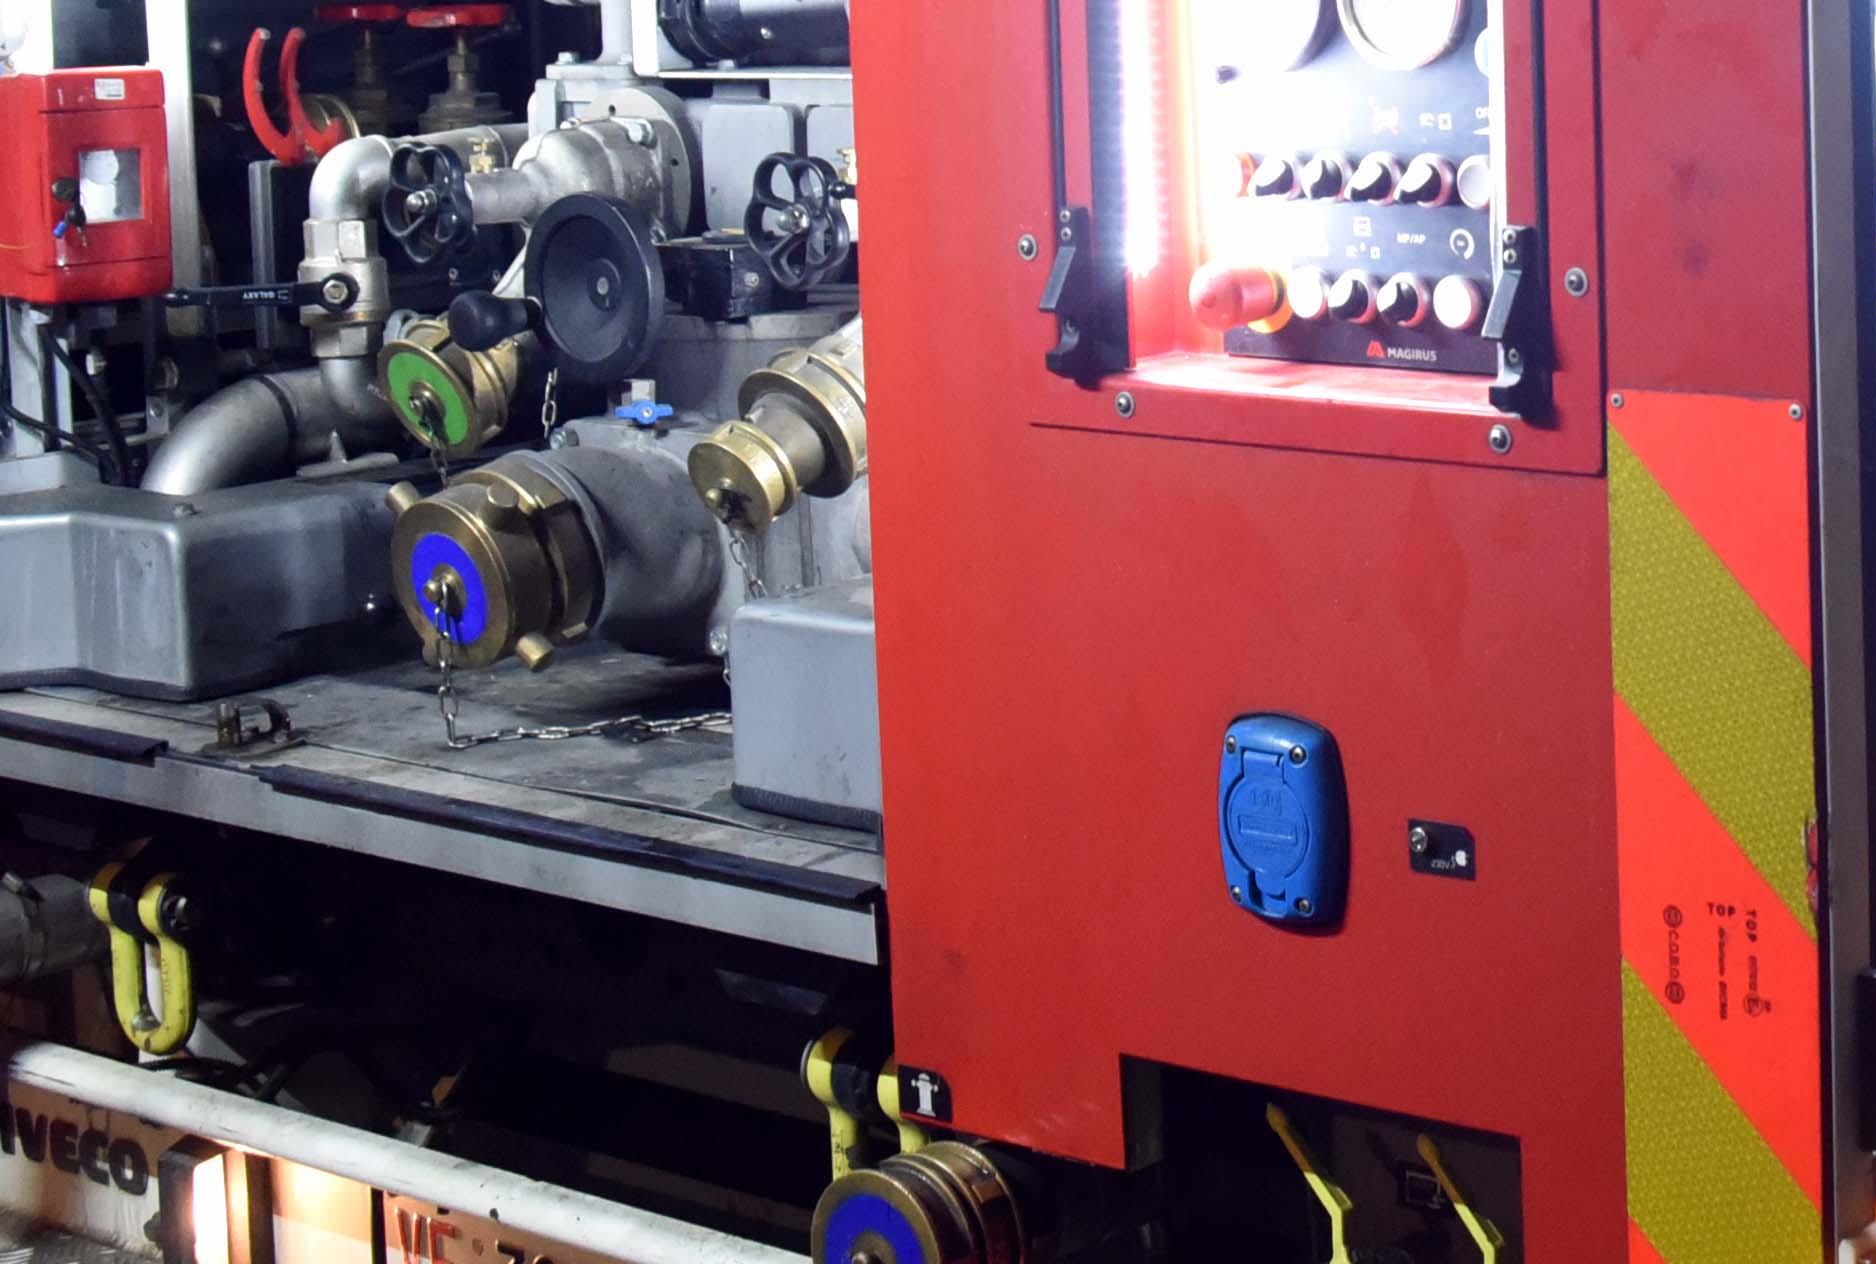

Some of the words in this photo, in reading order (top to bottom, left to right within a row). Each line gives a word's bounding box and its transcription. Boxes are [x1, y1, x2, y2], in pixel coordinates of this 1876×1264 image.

[243, 291, 275, 300] GALAXY
[1387, 346, 1437, 363] MAGIRUS
[1707, 902, 1736, 917] TOP
[1746, 909, 1757, 943] TOP
[0, 1101, 149, 1197] IVECO
